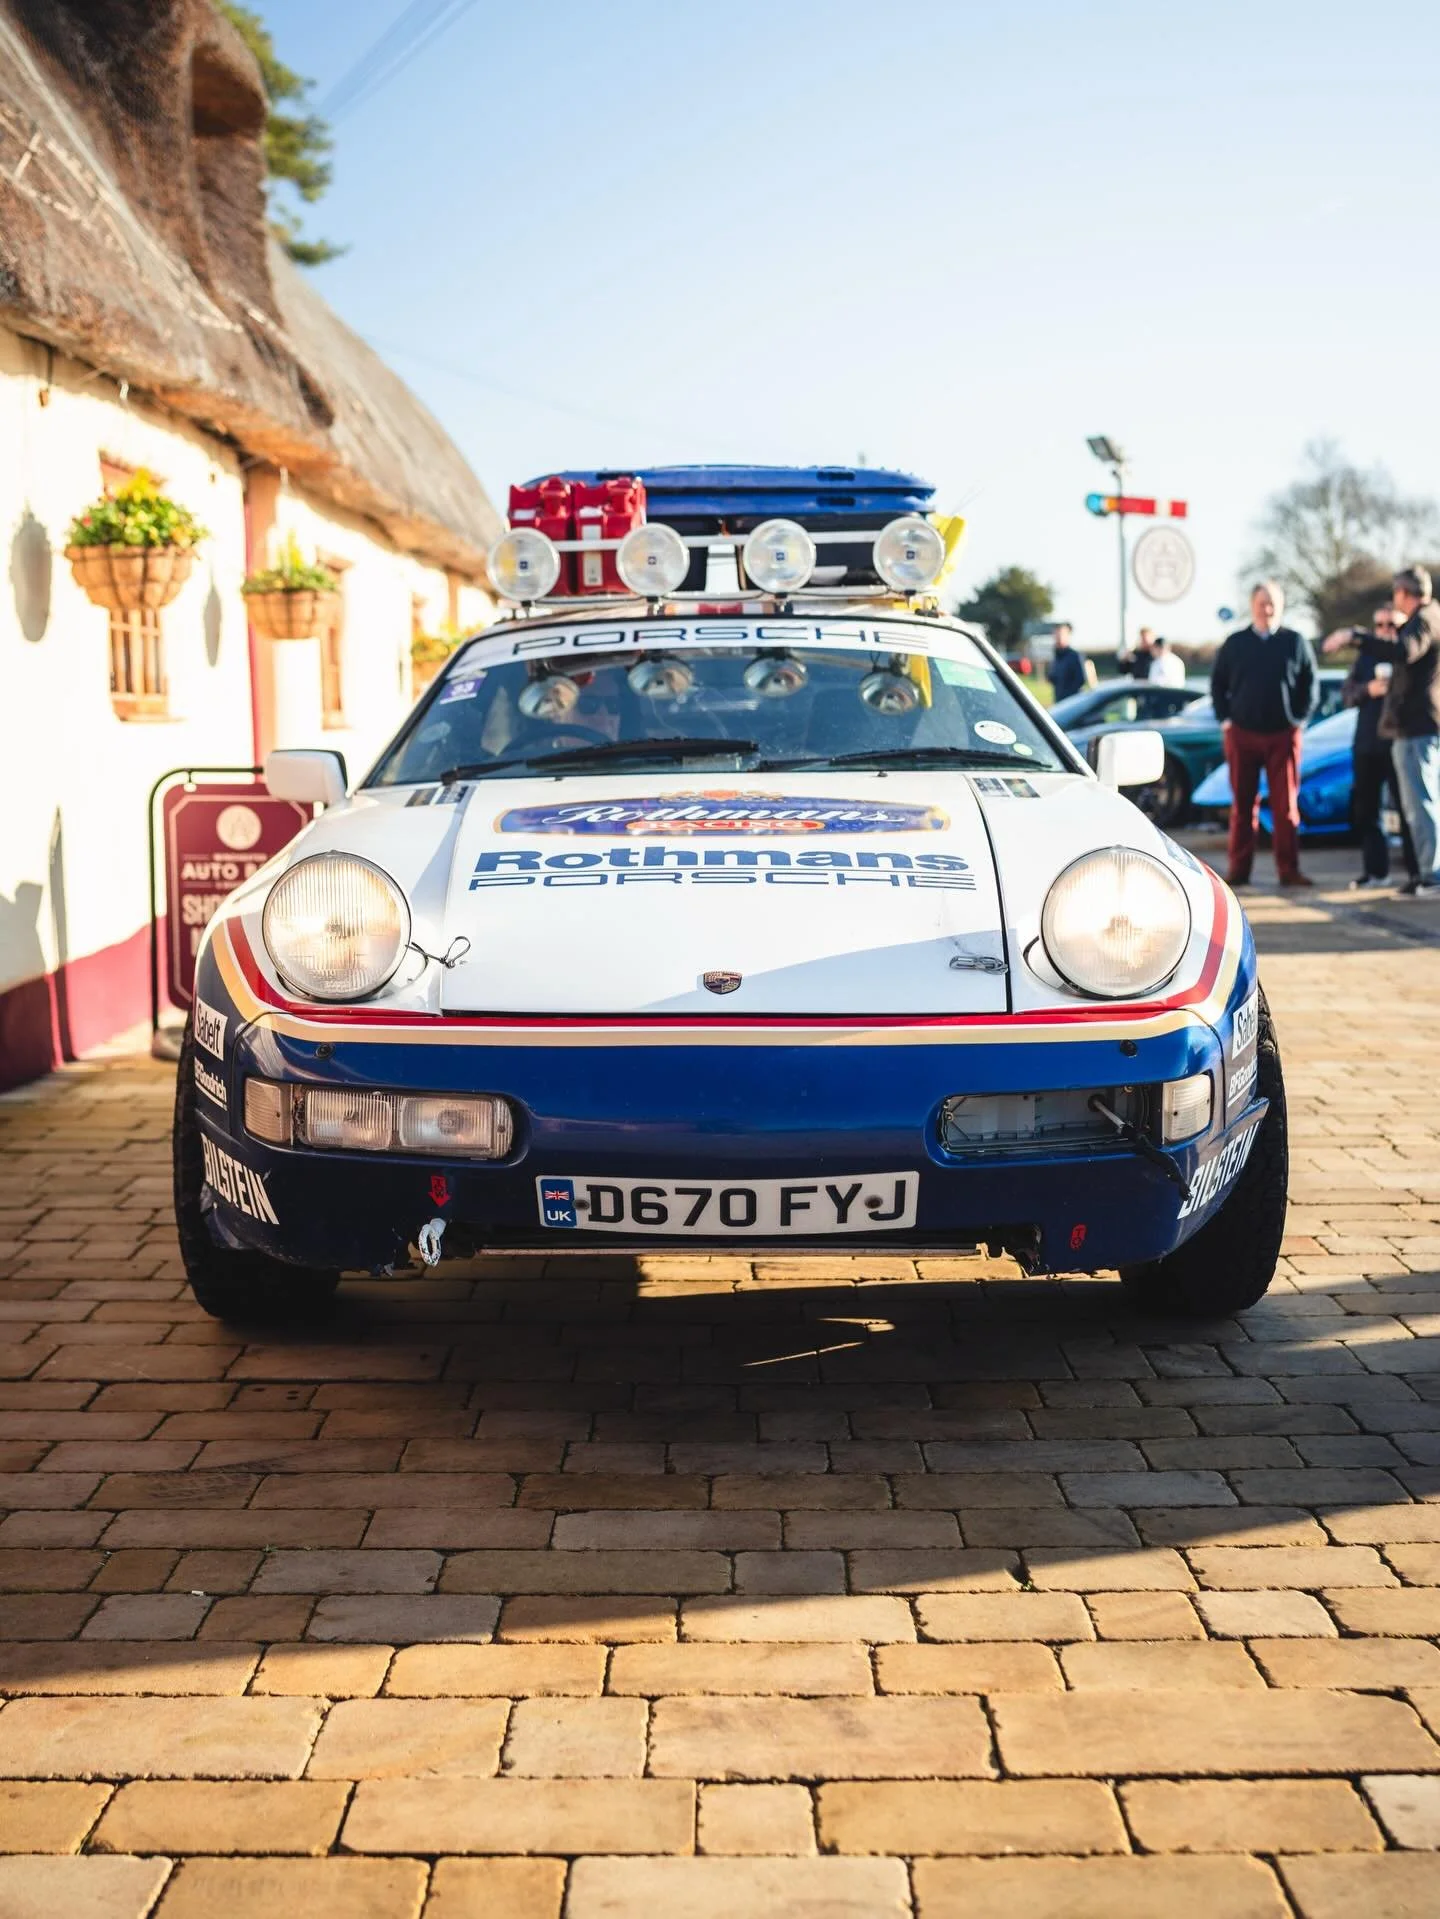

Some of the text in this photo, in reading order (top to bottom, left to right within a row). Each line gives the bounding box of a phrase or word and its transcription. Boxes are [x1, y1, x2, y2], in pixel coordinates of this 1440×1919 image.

[511, 625, 929, 655] PORSCHE
[541, 805, 905, 824] Rothmans
[646, 820, 808, 830] RACING
[181, 862, 239, 881] AUTO
[473, 846, 969, 873] Rothmans
[468, 871, 977, 892] PORSCHE
[197, 1003, 222, 1055] Sabelt
[200, 1131, 280, 1225] BILSTEIN
[1176, 1120, 1260, 1220] BILSTEIN
[546, 1209, 572, 1222] UK
[586, 1179, 907, 1228] D670 FYJ
